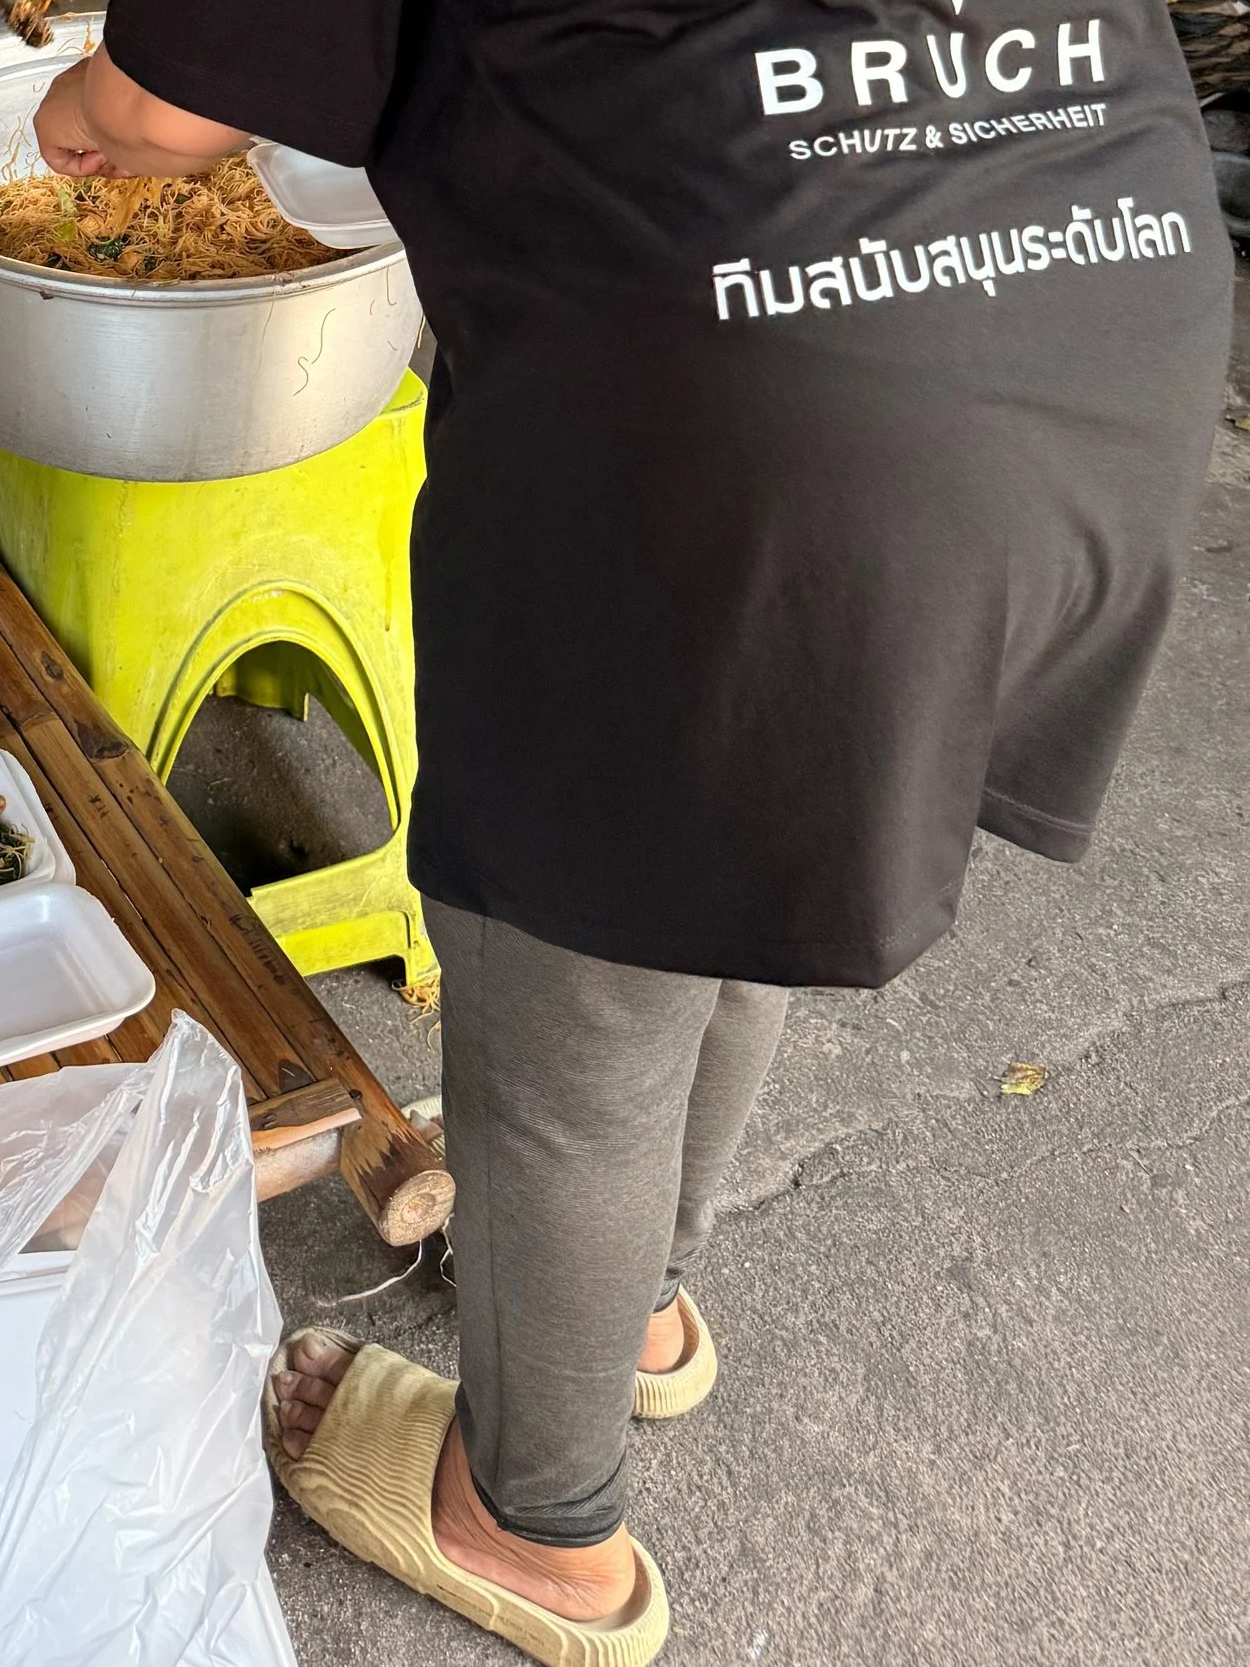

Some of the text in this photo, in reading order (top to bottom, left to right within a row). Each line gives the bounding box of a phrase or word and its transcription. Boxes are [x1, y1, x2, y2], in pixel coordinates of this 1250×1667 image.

[754, 18, 1107, 116] BRUCH
[788, 102, 1108, 161] SCHUTZ & SICHERHEIT
[711, 197, 1192, 322] ทีมสนับสนุนระดับโลก
